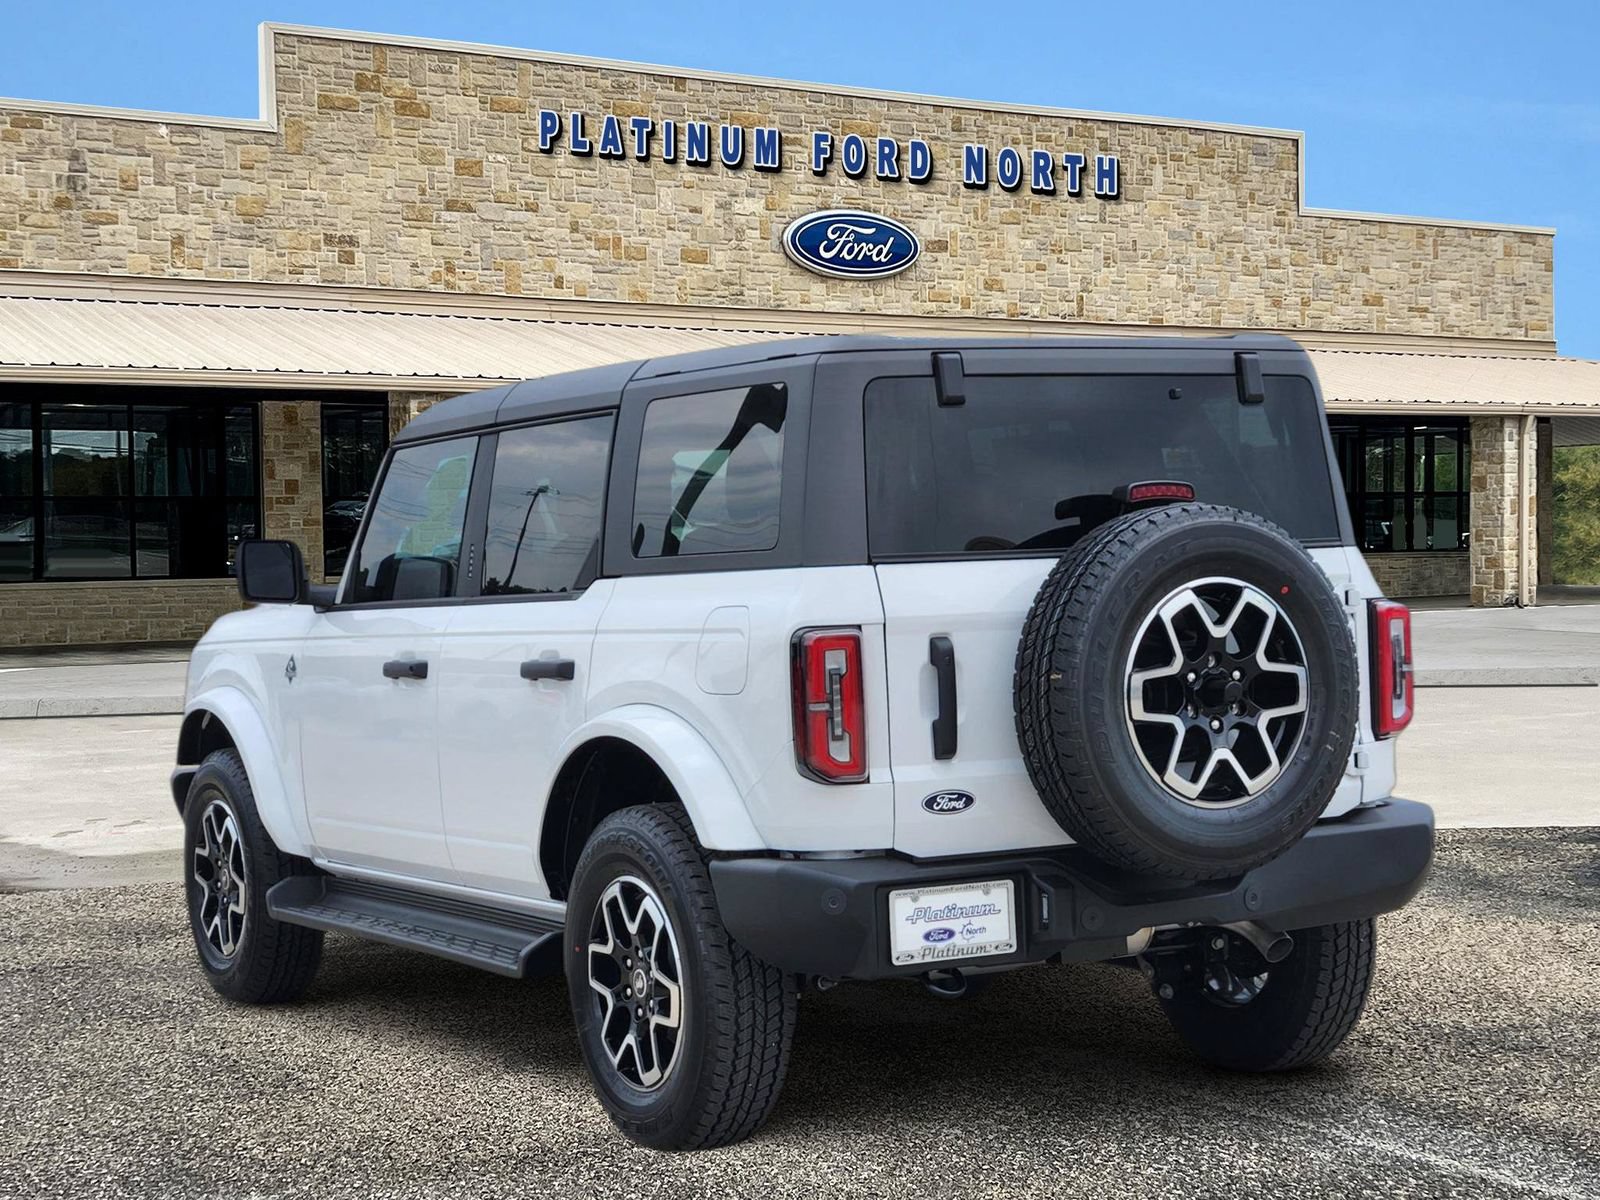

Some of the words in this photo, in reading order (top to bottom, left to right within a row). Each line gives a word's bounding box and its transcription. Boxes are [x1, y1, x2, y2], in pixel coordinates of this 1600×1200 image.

[538, 109, 783, 173] PLATINUM
[811, 130, 934, 185] FORD
[962, 142, 1122, 200] NORTH
[818, 221, 895, 264] Ford
[933, 794, 966, 811] Ford
[905, 903, 1001, 924] Platinum
[928, 929, 950, 942] Ford
[966, 925, 987, 935] North
[921, 942, 988, 961] Platinum
